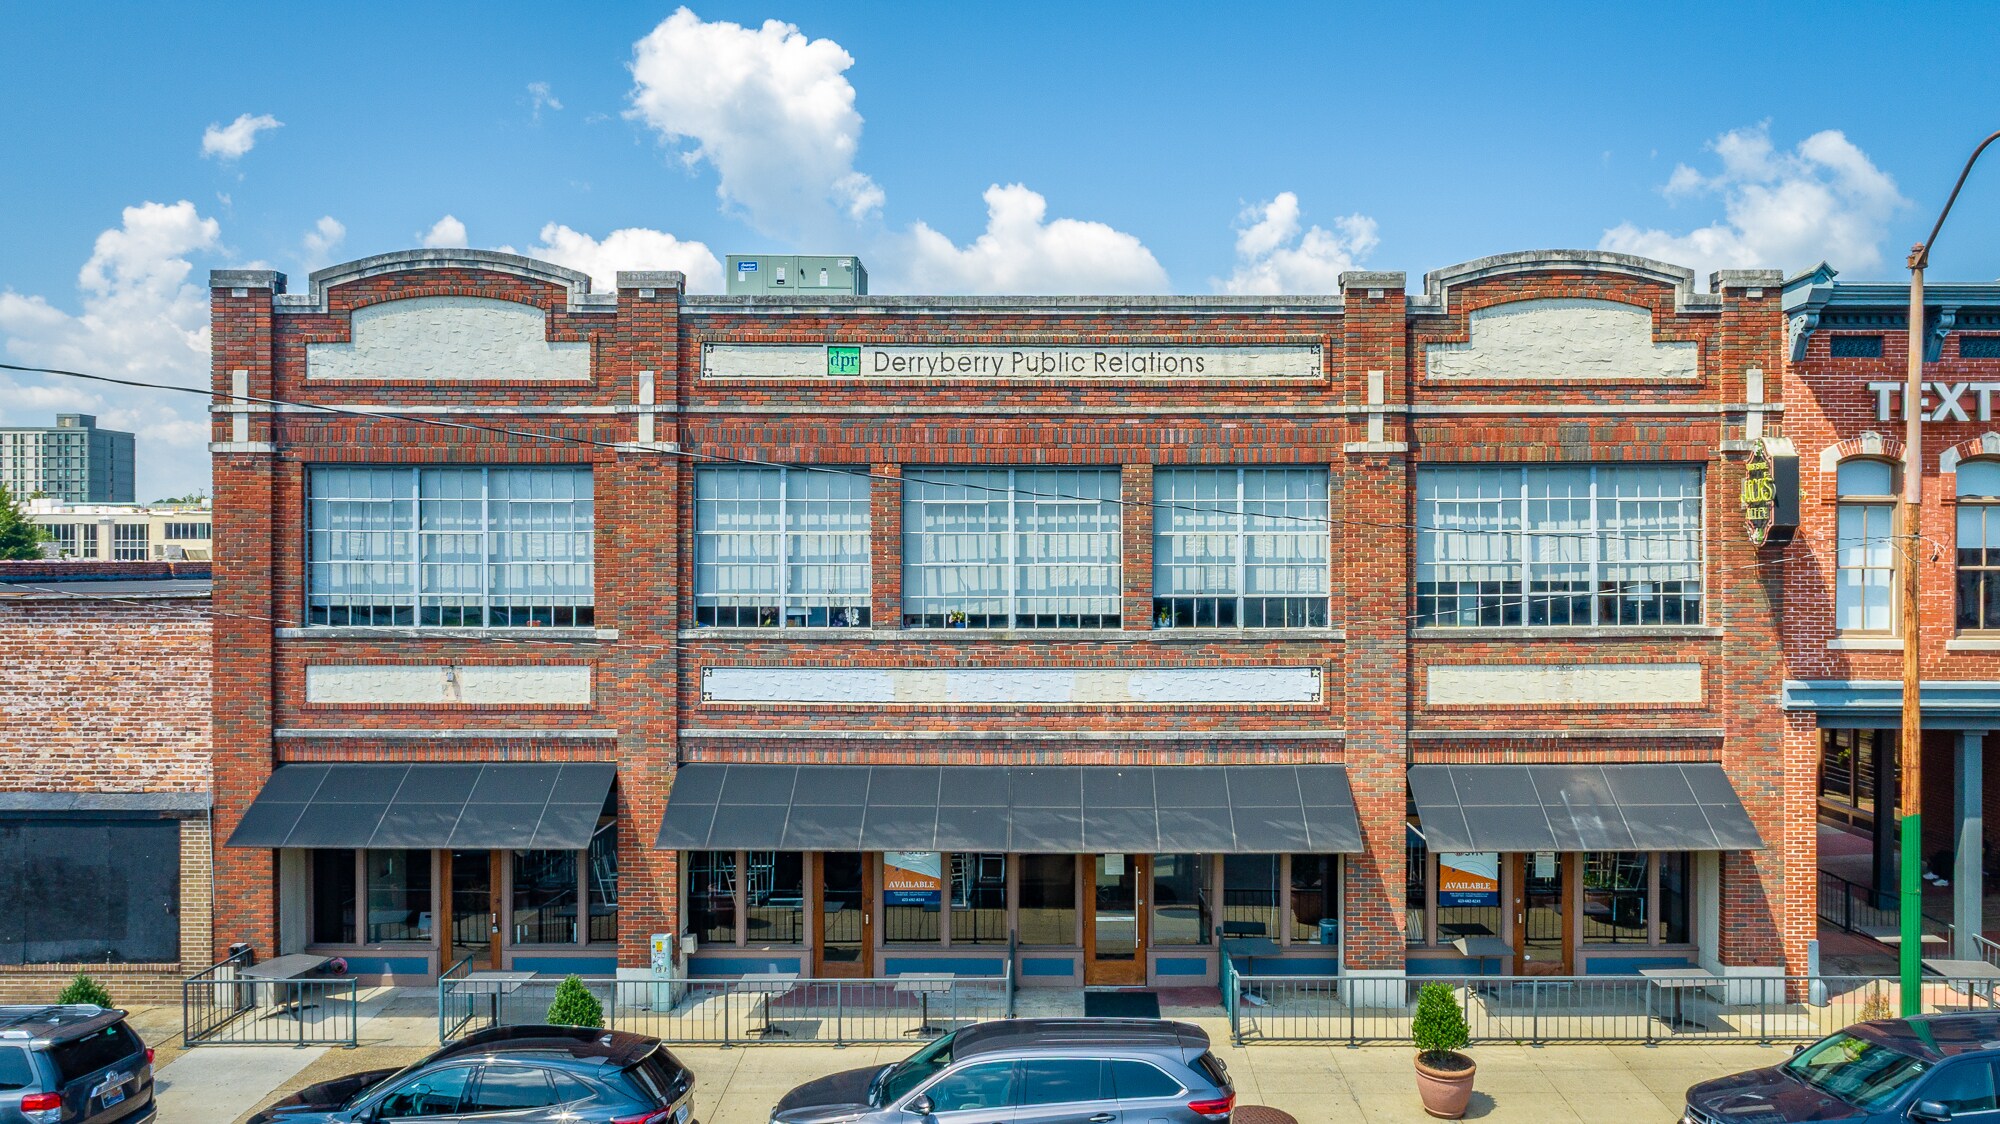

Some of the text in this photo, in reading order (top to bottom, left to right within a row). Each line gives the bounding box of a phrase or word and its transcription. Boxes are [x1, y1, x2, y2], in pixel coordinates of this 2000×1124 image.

[830, 351, 858, 372] dpr
[874, 351, 1205, 377] Derryberry Public Relations
[1867, 381, 2000, 421] TEXT
